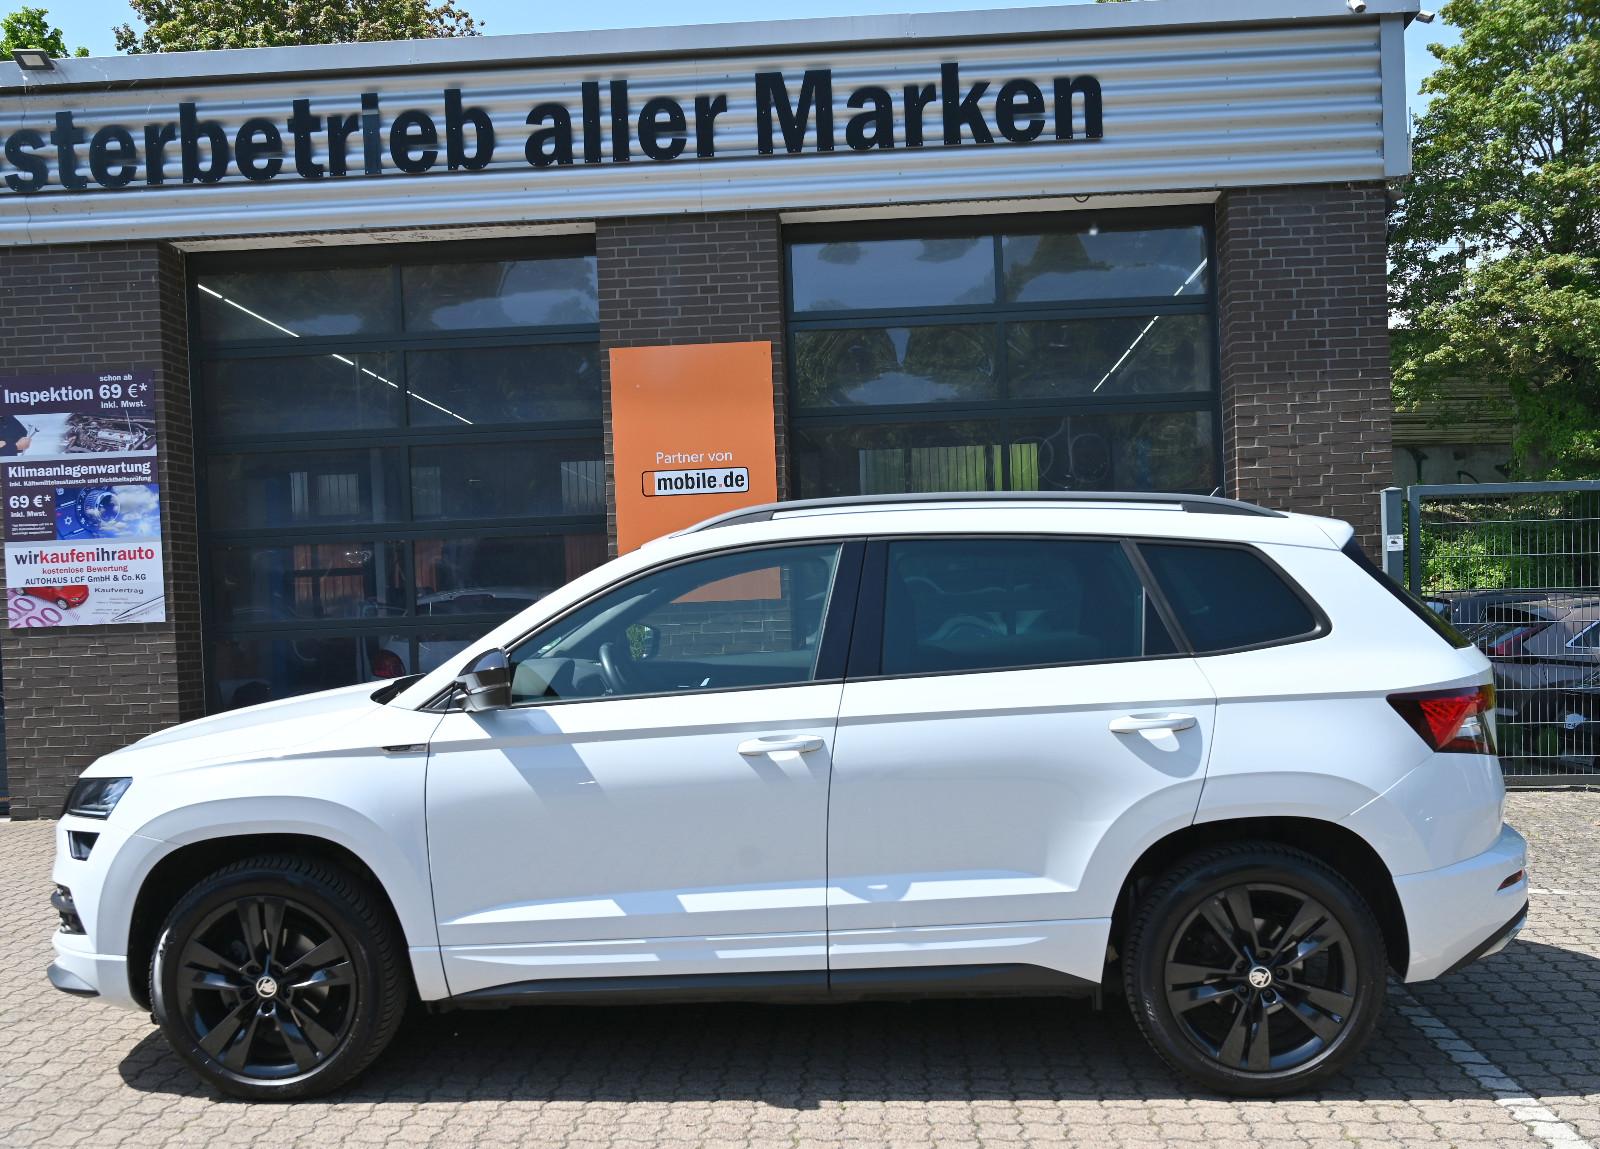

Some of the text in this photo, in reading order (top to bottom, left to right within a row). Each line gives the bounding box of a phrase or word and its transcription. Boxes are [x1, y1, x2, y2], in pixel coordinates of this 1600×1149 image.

[5, 62, 1103, 193] sterbetrieb aller Marken
[99, 373, 133, 382] schon ab
[4, 386, 94, 405] Inspektion
[99, 383, 122, 399] 69
[121, 400, 147, 408] Mwst.
[655, 451, 733, 465] Partner von
[8, 461, 151, 478] Klimaanlagenwartung
[657, 471, 745, 491] mobile.de
[9, 495, 30, 509] 69
[14, 546, 155, 565] wirkaufenihrauto
[42, 565, 129, 575] kostenlose Bewertung
[25, 576, 68, 585] AUTOHAUS
[87, 575, 111, 583] GmbH
[94, 587, 144, 595] Kaufvertrag
